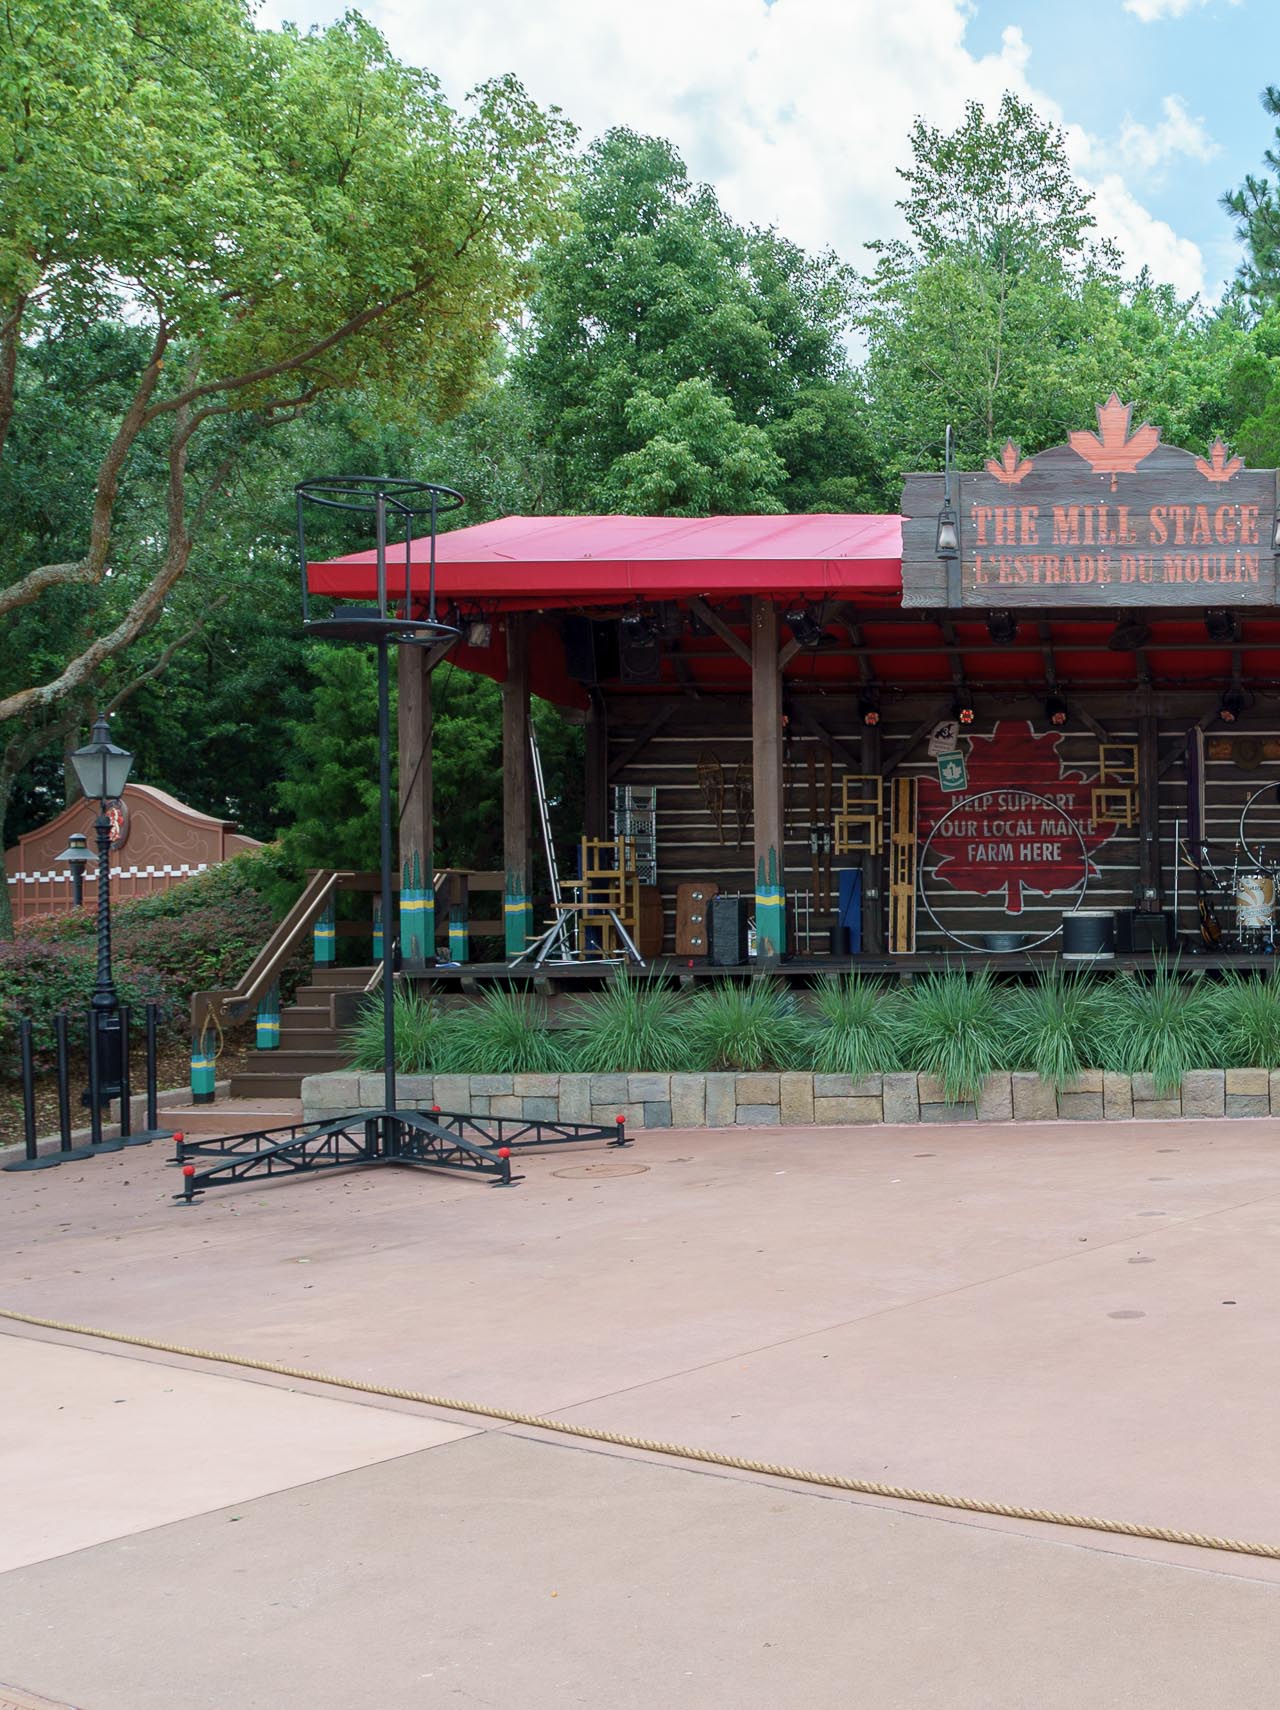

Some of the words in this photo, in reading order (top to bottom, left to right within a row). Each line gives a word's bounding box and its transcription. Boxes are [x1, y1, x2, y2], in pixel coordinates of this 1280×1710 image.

[971, 505, 1039, 545] THE
[1052, 505, 1137, 545] MILL
[1150, 504, 1260, 545] STAGE
[974, 554, 1112, 584] L'ESTRADE
[1120, 554, 1154, 583] DU
[1163, 554, 1260, 583] MOULIN
[952, 794, 993, 812] HELP
[998, 793, 1076, 811] SUPPORT
[983, 819, 1036, 837] LOCAL
[967, 843, 1014, 862] FARM
[1020, 842, 1062, 861] HERE
